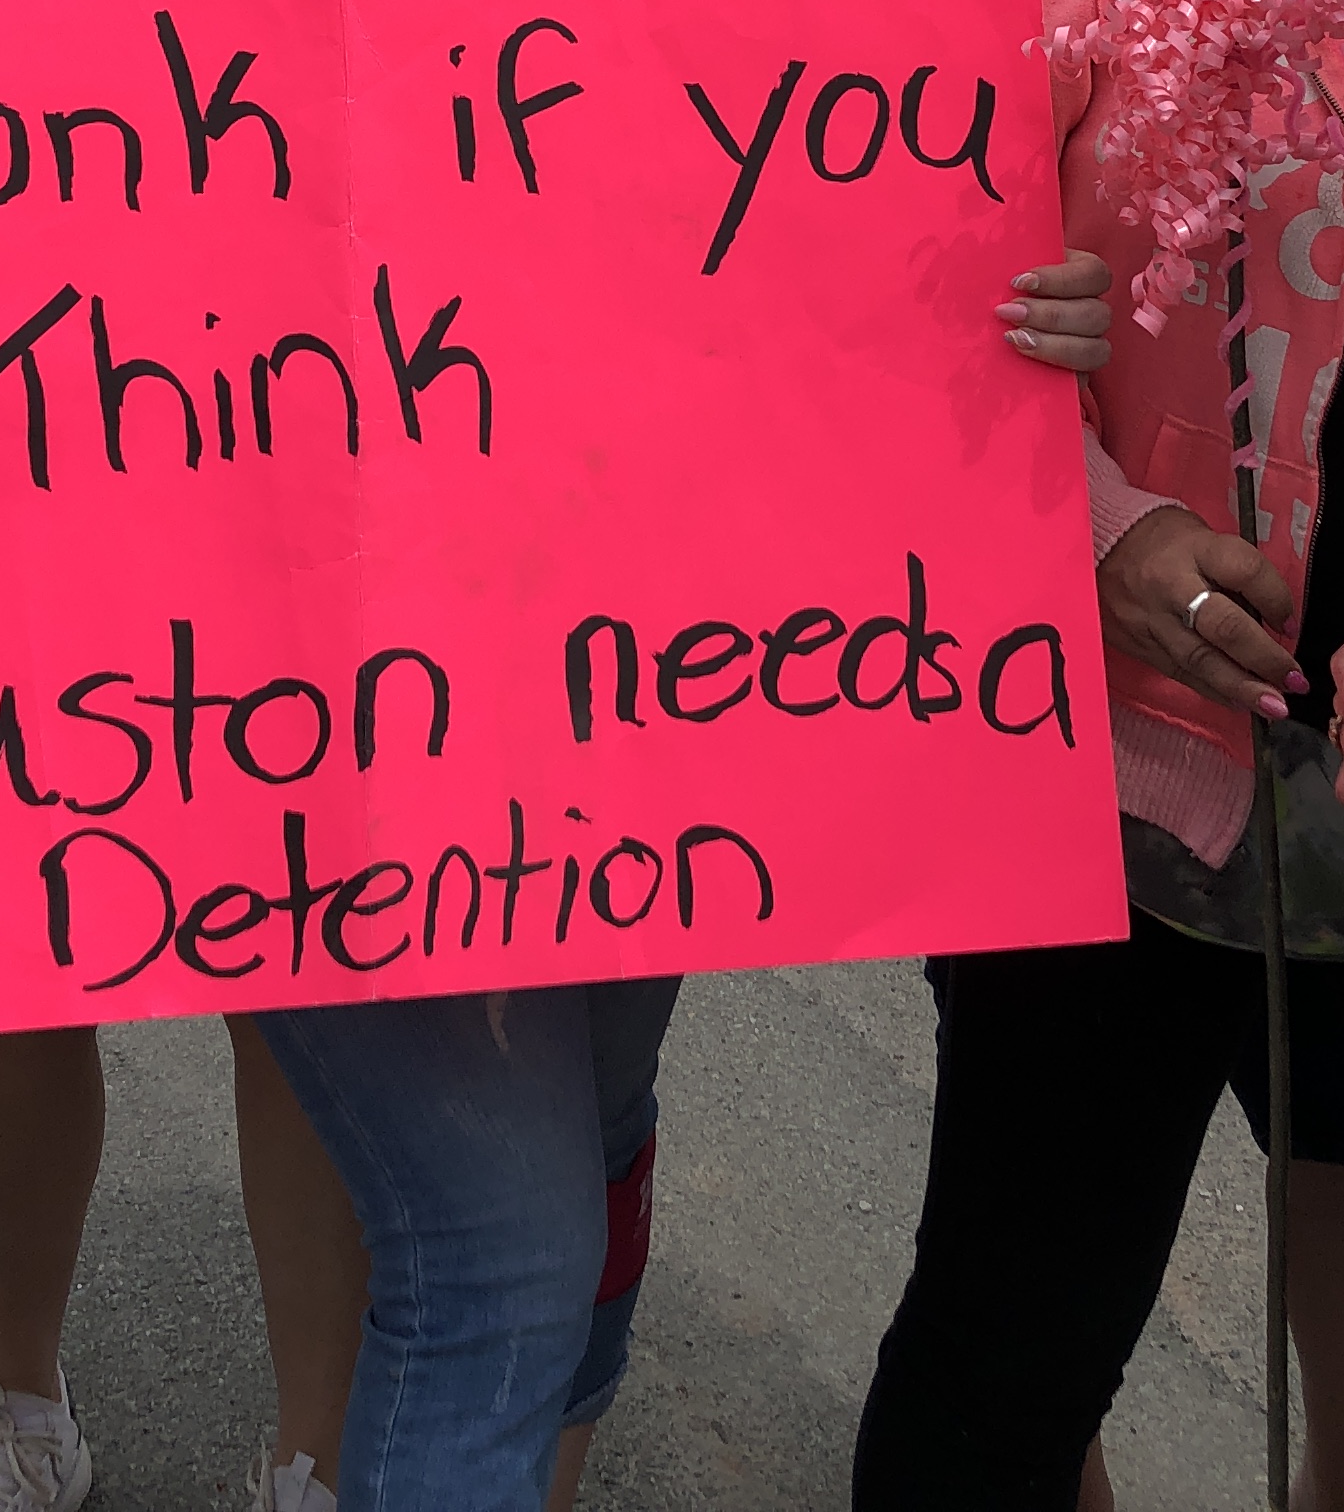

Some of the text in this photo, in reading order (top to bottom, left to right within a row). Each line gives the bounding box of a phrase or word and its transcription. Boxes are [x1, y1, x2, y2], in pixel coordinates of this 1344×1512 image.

[451, 17, 585, 194] if
[682, 60, 1006, 276] you
[40, 799, 774, 992] Detention
